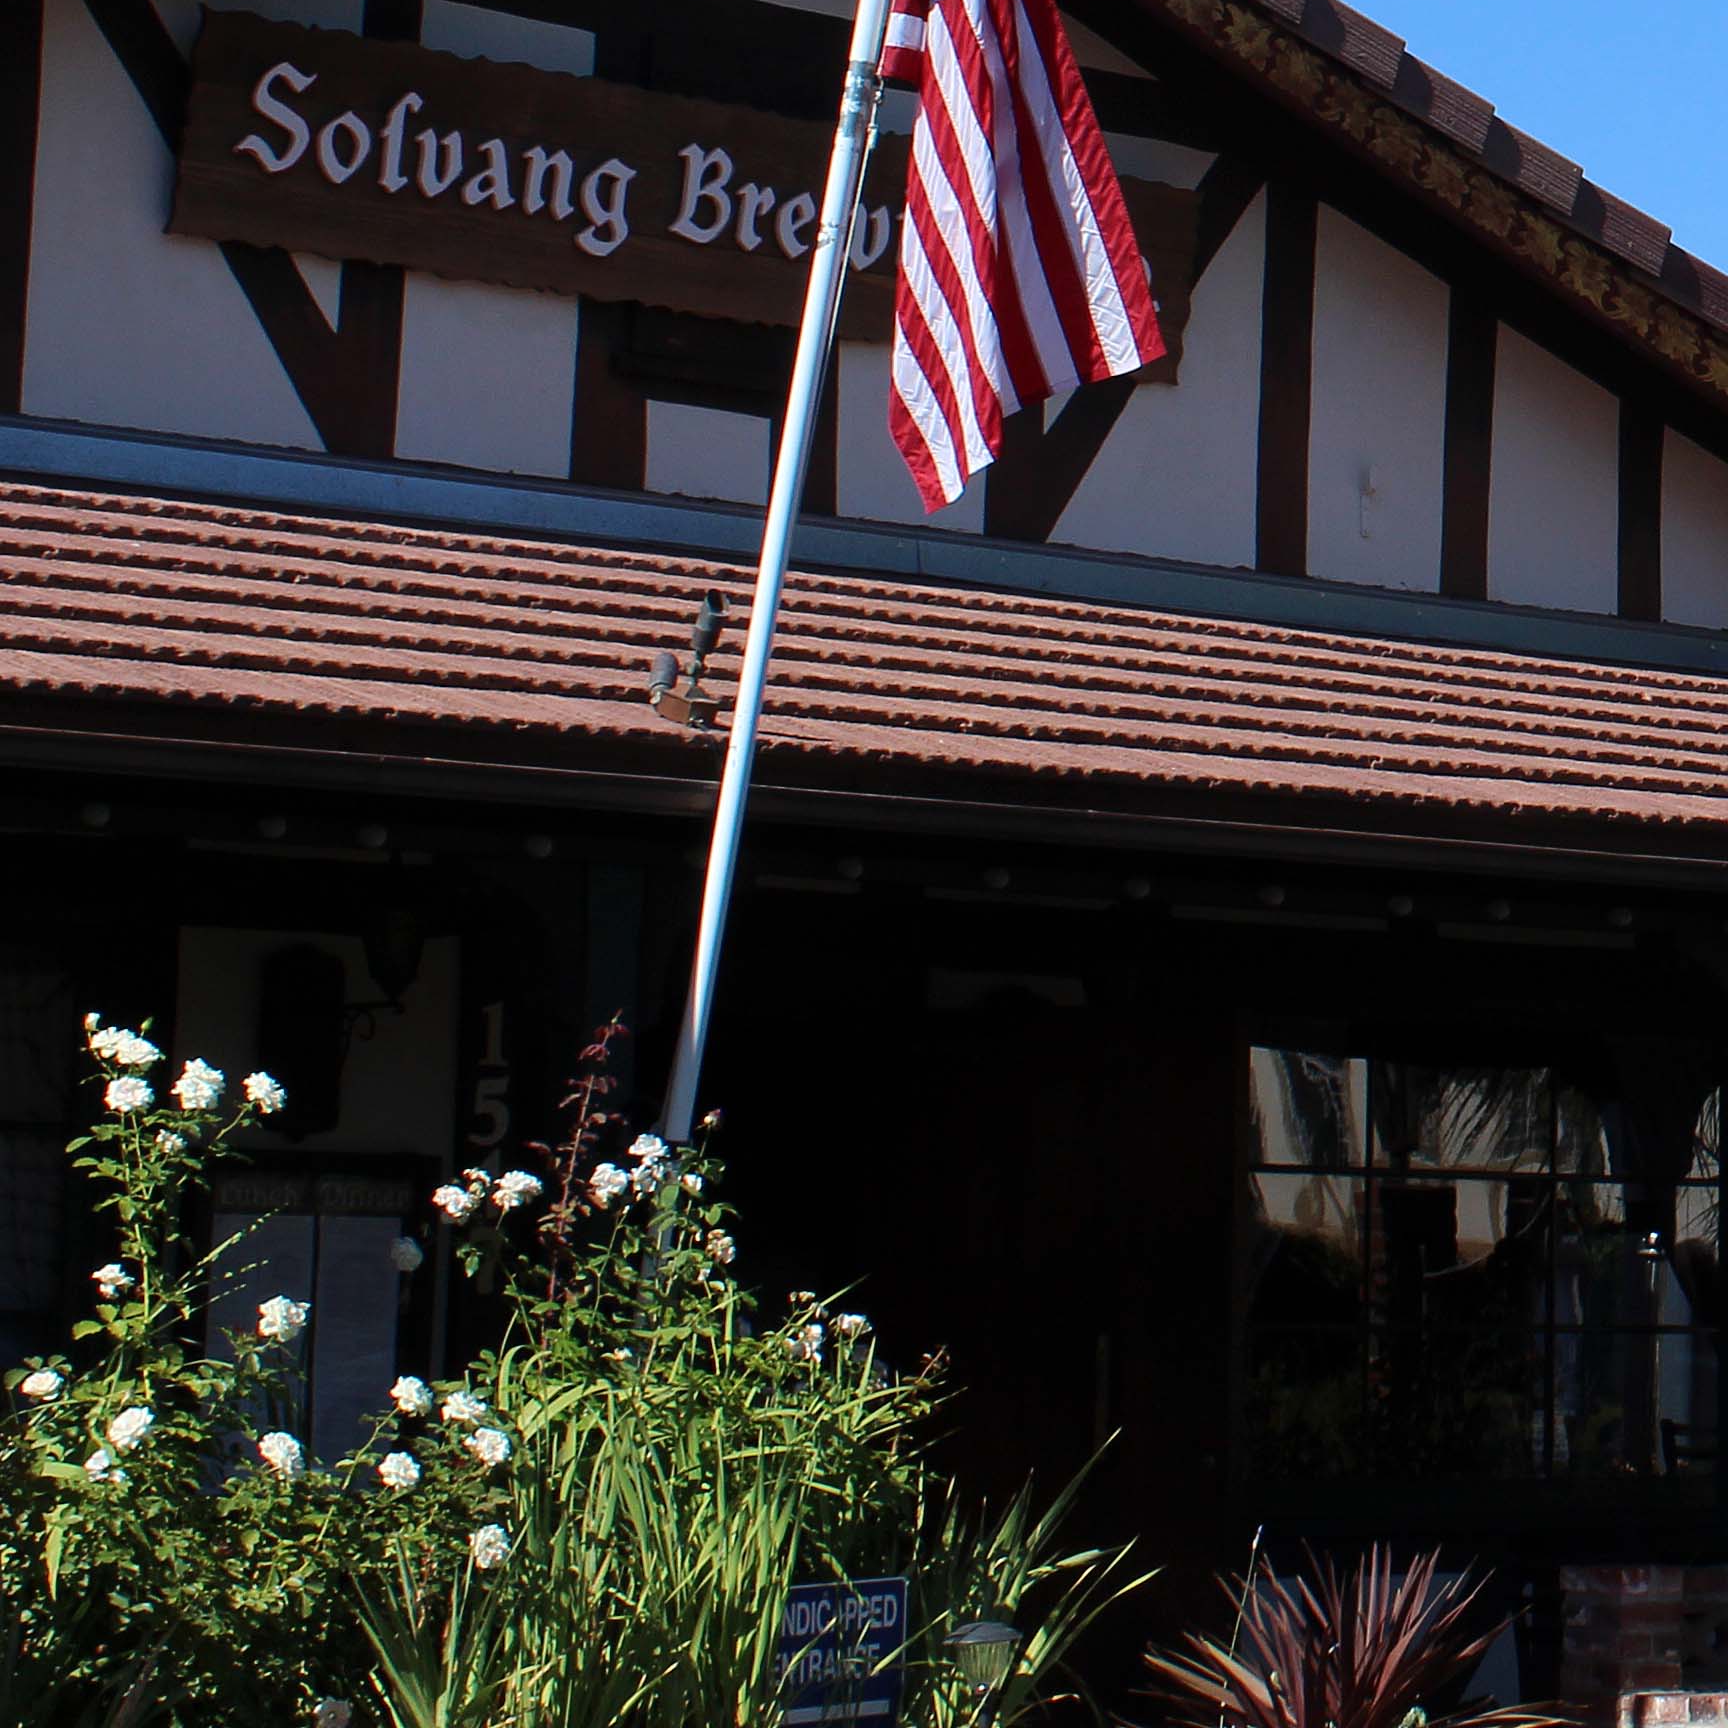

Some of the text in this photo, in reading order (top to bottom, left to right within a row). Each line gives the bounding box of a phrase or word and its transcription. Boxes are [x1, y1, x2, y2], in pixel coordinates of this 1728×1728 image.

[235, 60, 901, 273] Solvang Brew
[780, 1594, 898, 1638] NDICPPED
